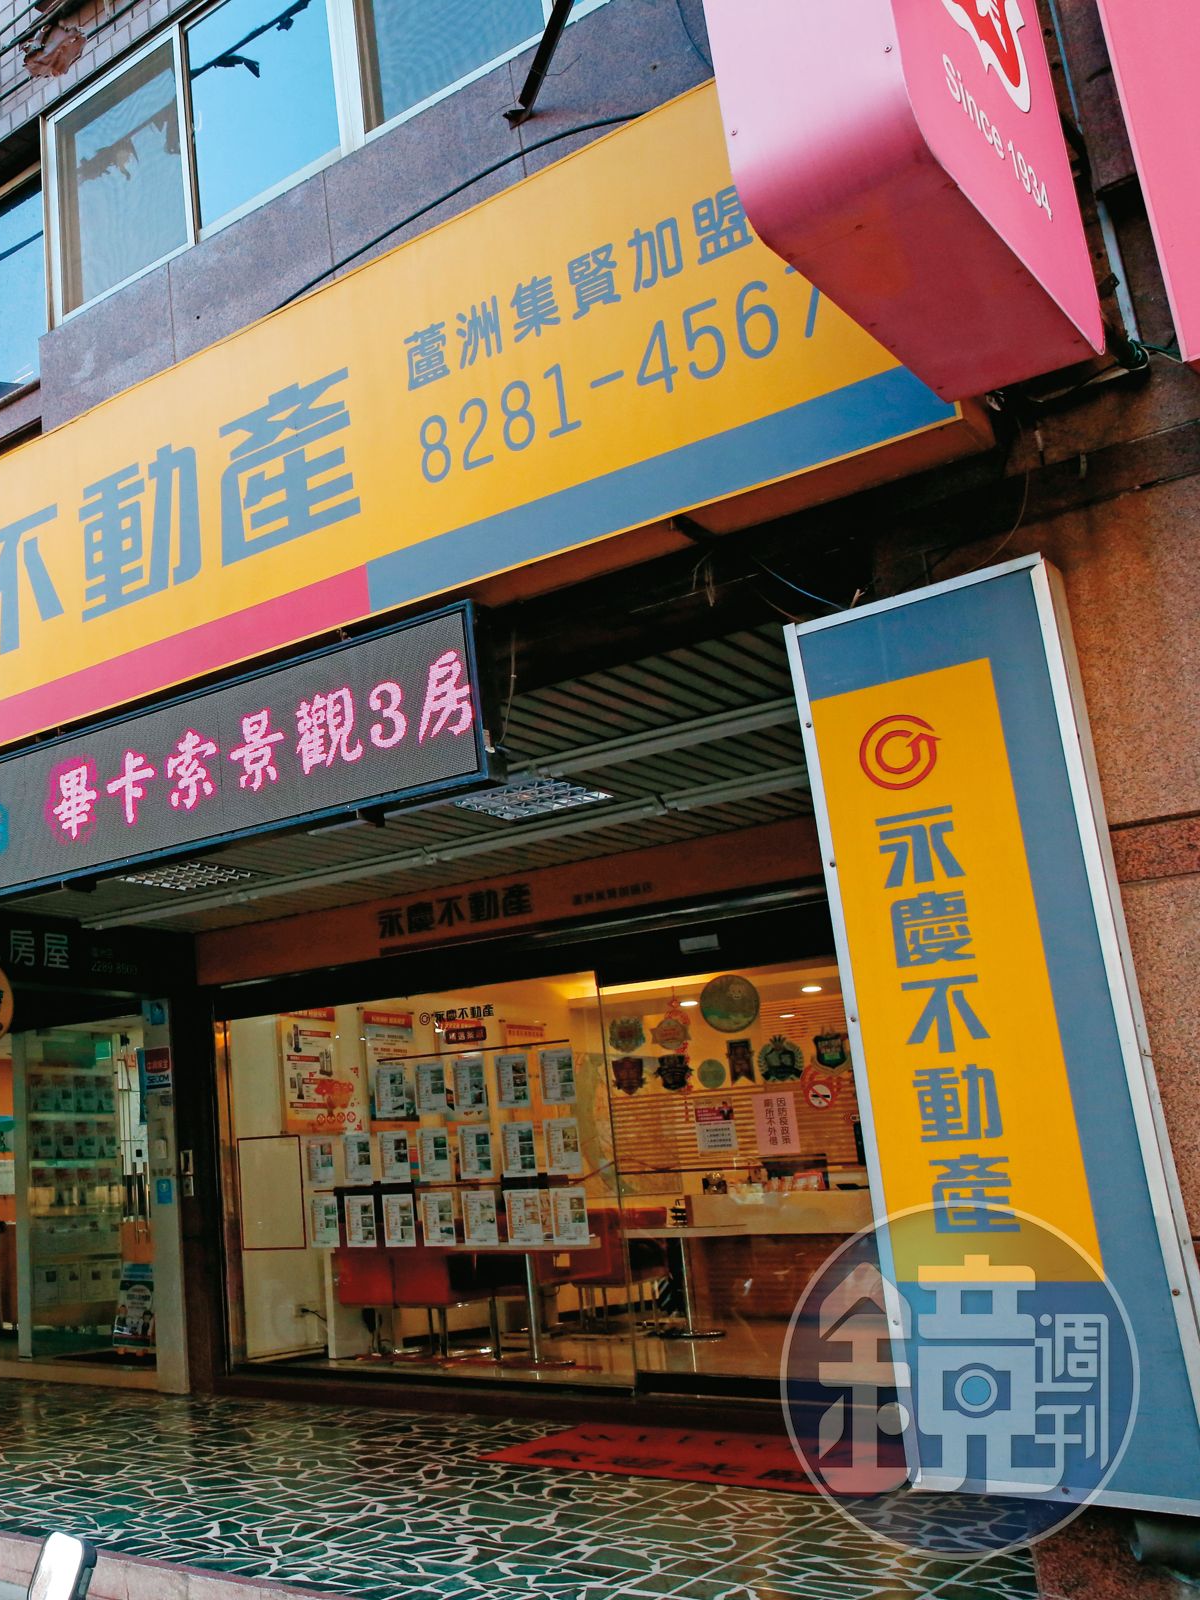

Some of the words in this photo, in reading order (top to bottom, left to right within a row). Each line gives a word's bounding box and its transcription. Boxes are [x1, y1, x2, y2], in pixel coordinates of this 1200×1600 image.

[941, 54, 1006, 160] Since
[1004, 140, 1055, 222] 1934
[403, 184, 758, 393] 蘆洲集賢加盟
[52, 649, 474, 840] 畢卡索景觀3房
[377, 882, 534, 939] 永慶不動產
[874, 804, 1022, 1235] 永慶不動產
